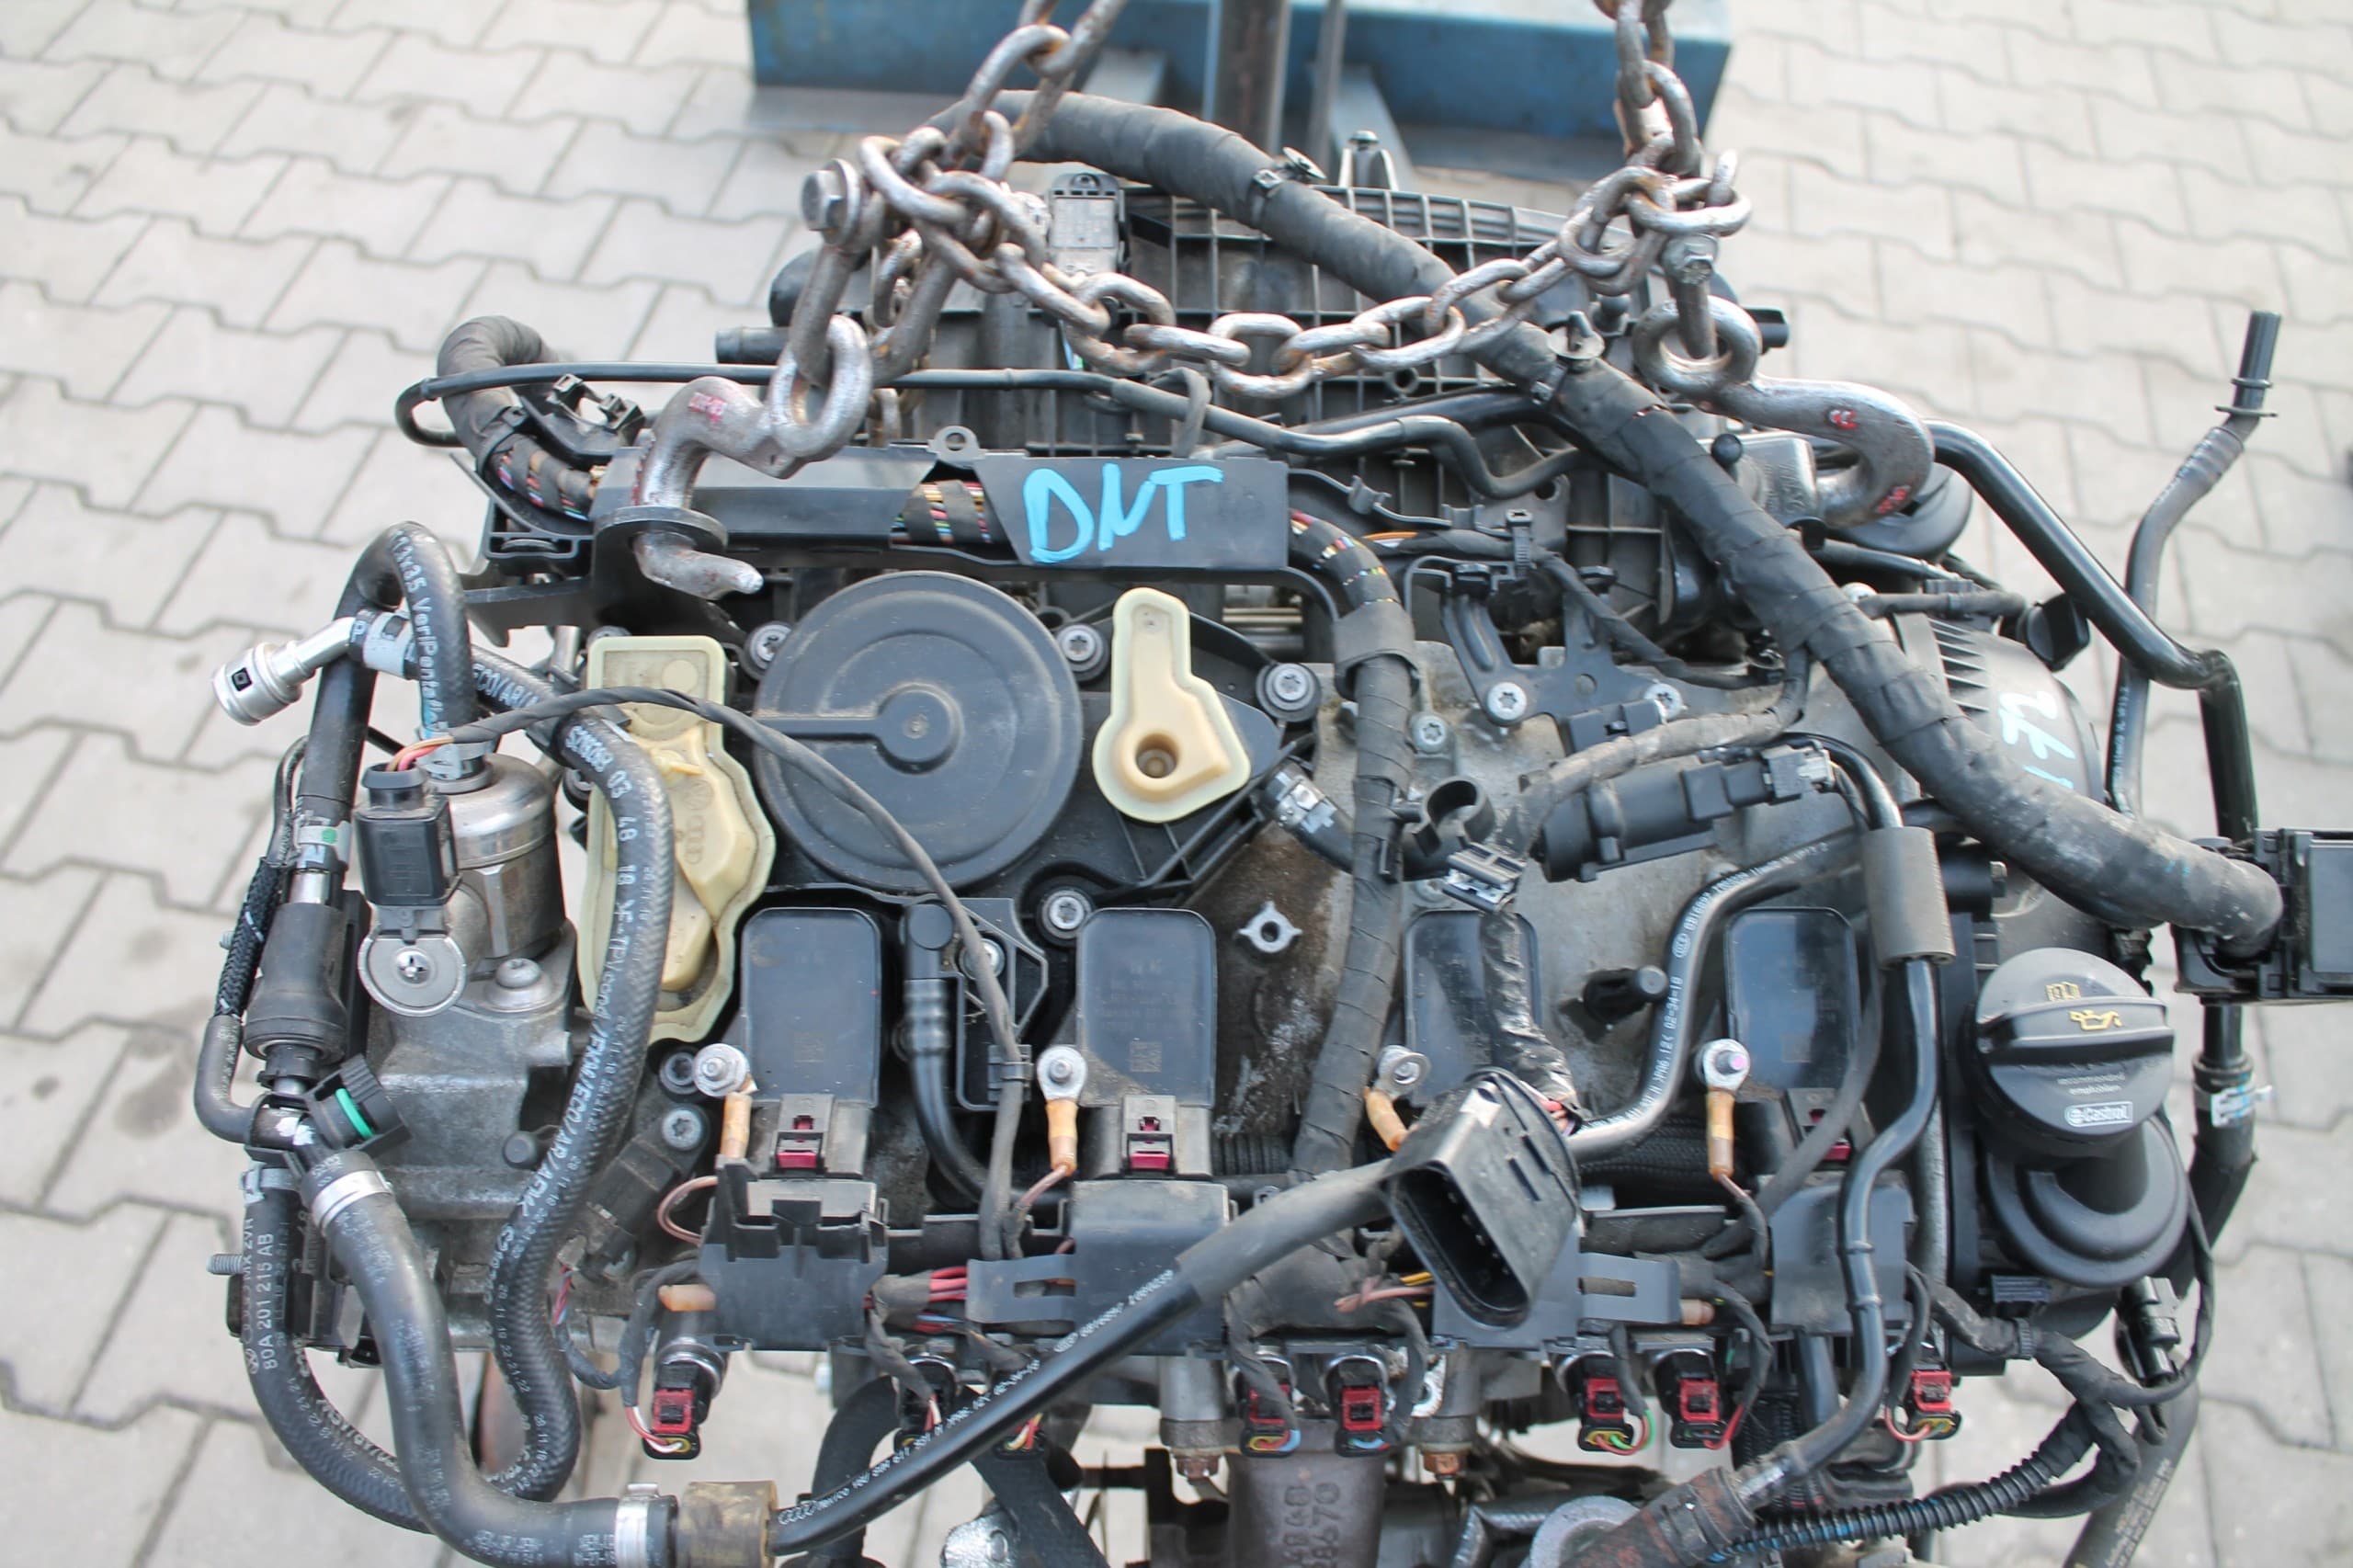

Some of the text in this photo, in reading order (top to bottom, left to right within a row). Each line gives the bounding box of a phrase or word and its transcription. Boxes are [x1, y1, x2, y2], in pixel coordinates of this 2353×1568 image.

[2085, 1105, 2128, 1122] Castrol
[256, 1233, 277, 1369] 80A 201 215 AB
